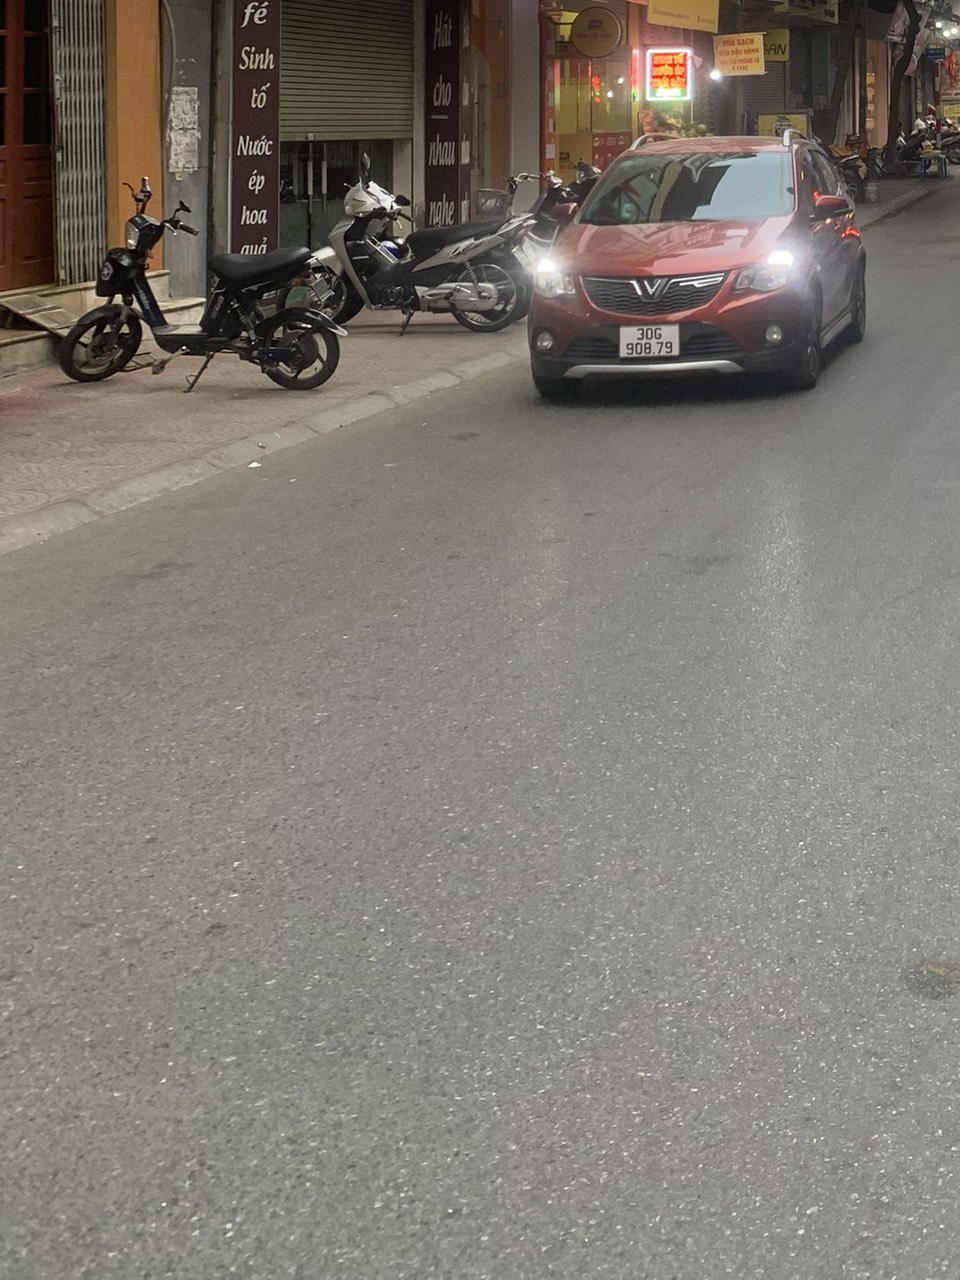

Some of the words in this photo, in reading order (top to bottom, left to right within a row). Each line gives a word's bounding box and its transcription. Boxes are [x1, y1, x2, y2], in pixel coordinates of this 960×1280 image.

[240, 1, 269, 28] fé
[432, 10, 453, 50] Hát
[238, 46, 275, 70] Sinh
[250, 82, 271, 109] tố
[433, 74, 451, 107] cho
[236, 135, 273, 156] Nước
[428, 133, 455, 166] nhau
[248, 169, 265, 194] ép
[240, 205, 268, 225] hoa
[429, 193, 455, 227] nghe
[636, 327, 662, 340] 30G
[625, 342, 673, 355] 908.79
